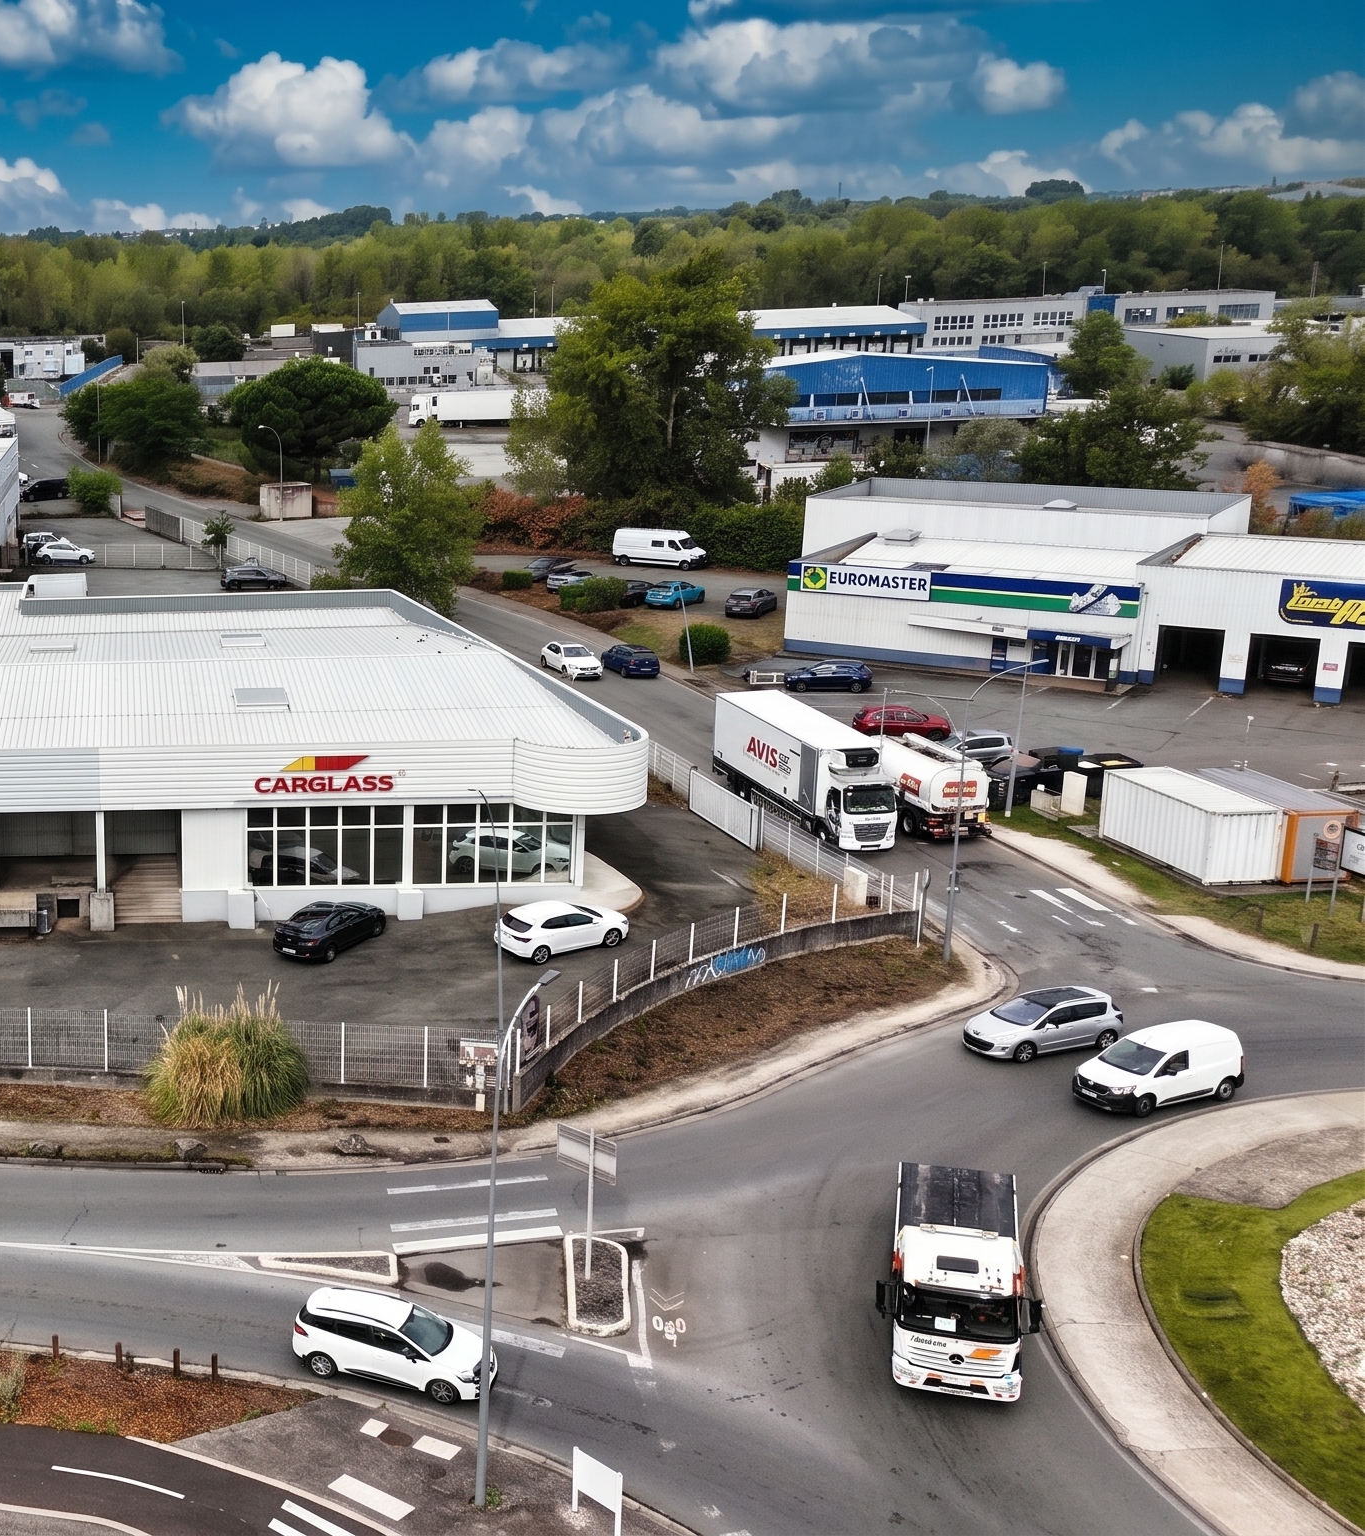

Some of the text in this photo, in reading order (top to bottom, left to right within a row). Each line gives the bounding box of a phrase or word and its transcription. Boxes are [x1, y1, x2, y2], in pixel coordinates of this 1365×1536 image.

[830, 572, 927, 591] EUROMASTER
[747, 736, 778, 768] AVIS
[254, 775, 393, 793] CARGLASS
